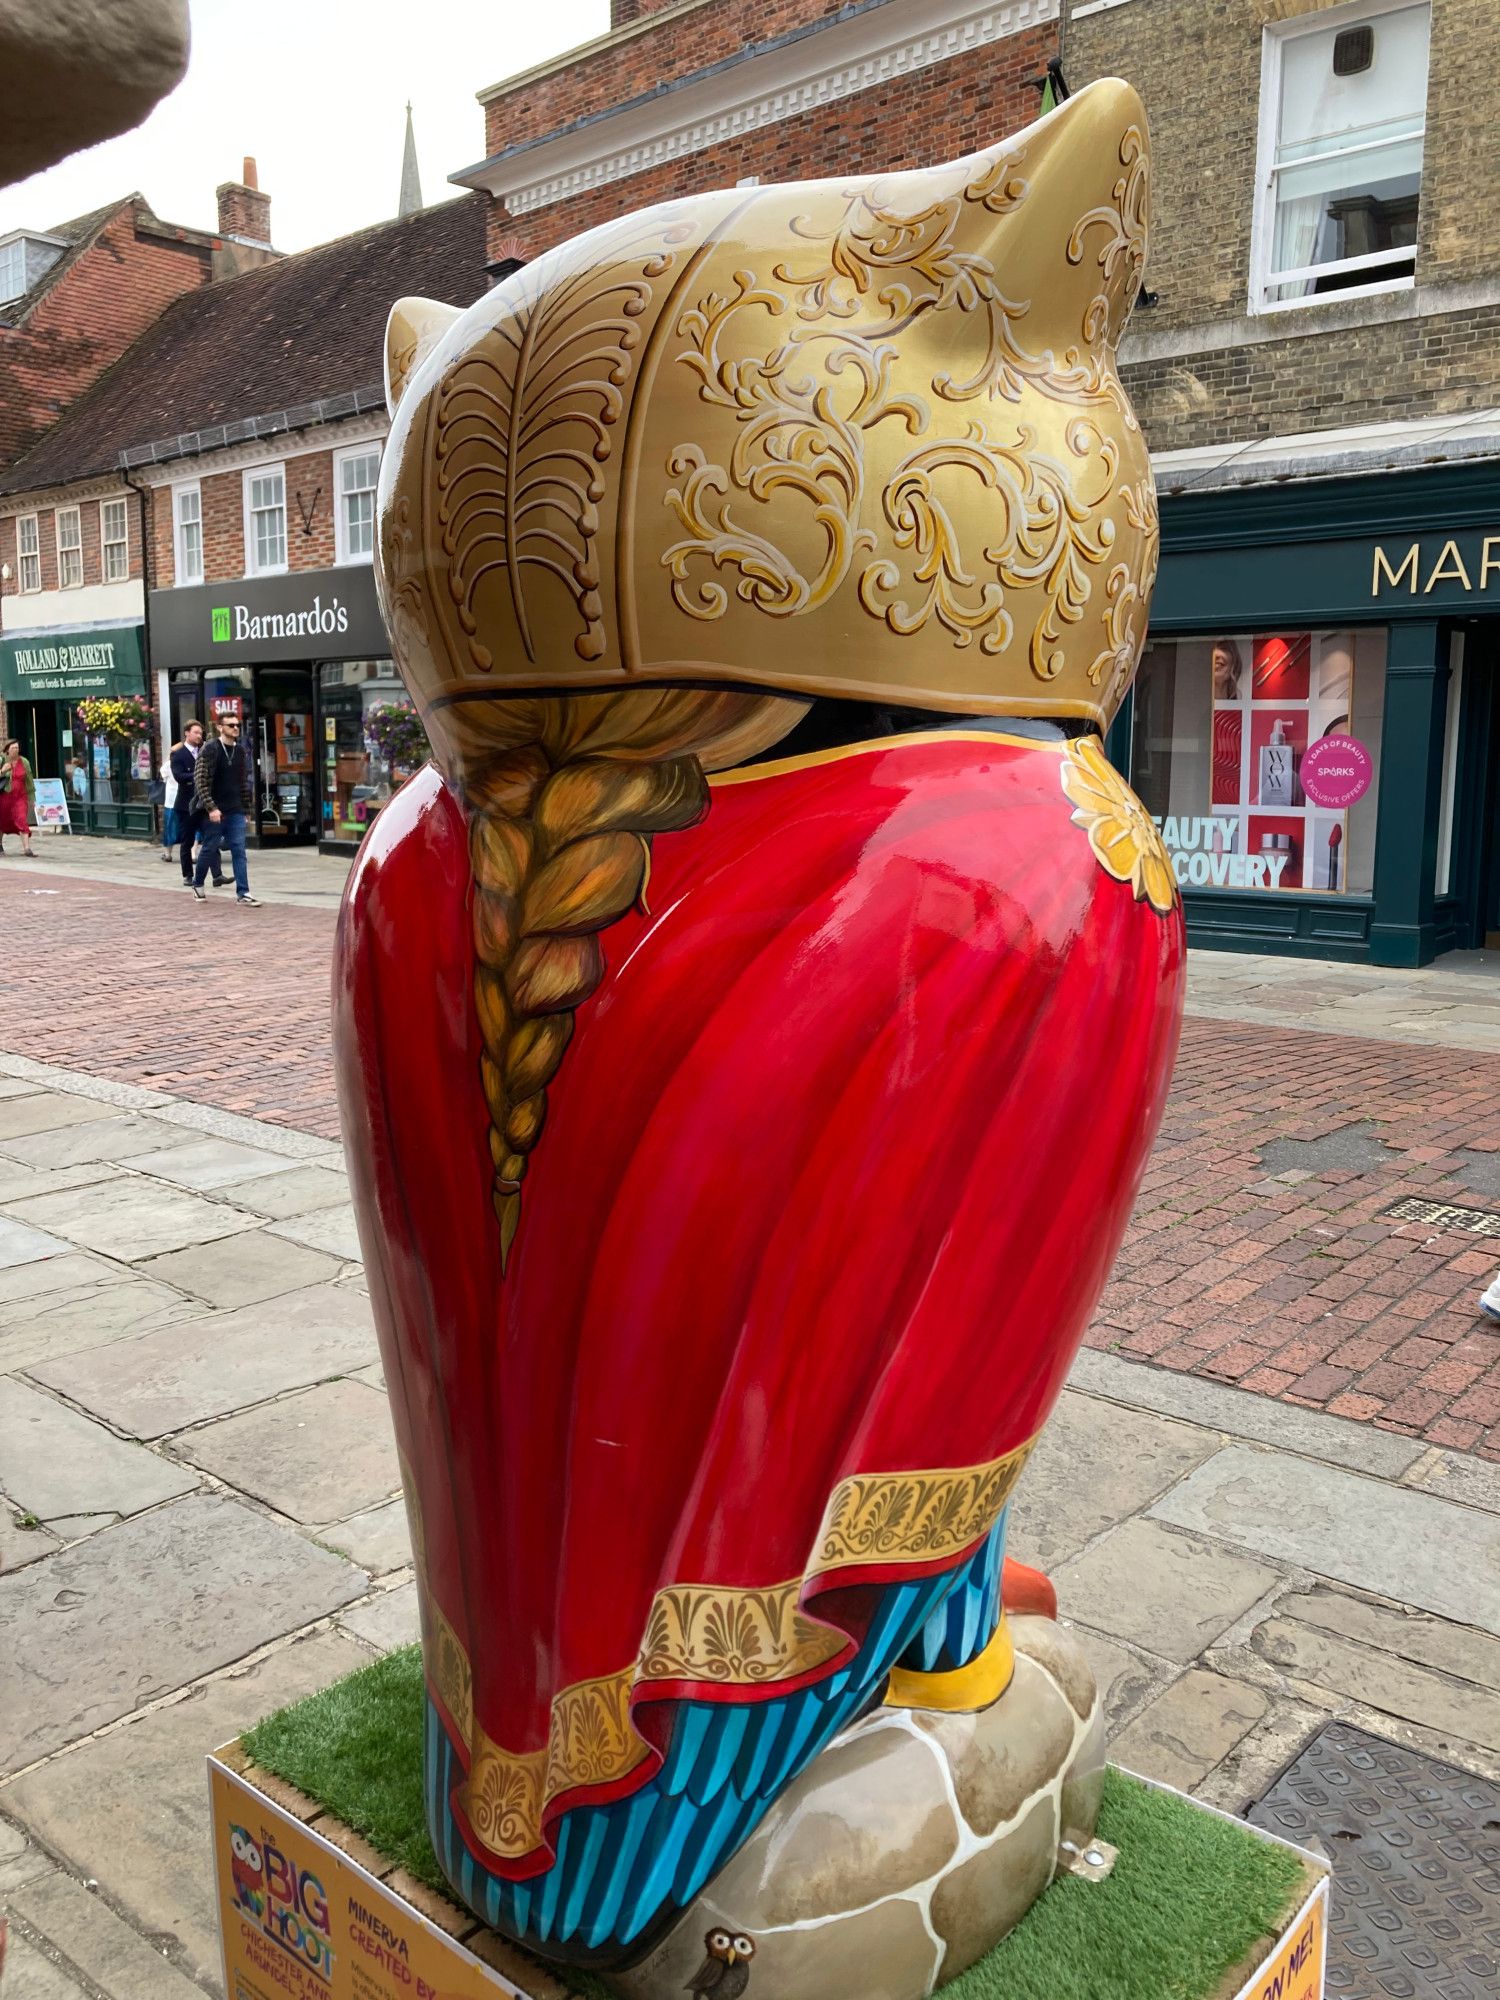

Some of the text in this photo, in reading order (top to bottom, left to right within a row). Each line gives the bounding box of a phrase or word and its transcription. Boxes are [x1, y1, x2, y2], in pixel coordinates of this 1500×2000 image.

[234, 596, 348, 640] Barnardo's
[15, 643, 115, 674] HOLLAND & BARRETT
[214, 700, 238, 713] SALE
[1311, 742, 1329, 758] DAYS
[1329, 740, 1341, 748] OF
[1342, 741, 1366, 765] BEAUTY
[1318, 767, 1355, 776] SPARKS
[1306, 779, 1365, 803] EXCLUSIVE OFFERS
[323, 801, 367, 820] HELLO
[1151, 816, 1240, 851] AUTY
[1169, 851, 1288, 888] COVERY
[260, 1824, 276, 1846] the
[263, 1844, 332, 1938] BIG
[267, 1895, 336, 1977] HOOT
[348, 1896, 409, 1964] MINERVA
[245, 1943, 296, 1996] ARUNDEL
[349, 1924, 412, 1985] CREATED
[416, 1977, 436, 2000] BY
[1287, 1921, 1314, 1990] ME!
